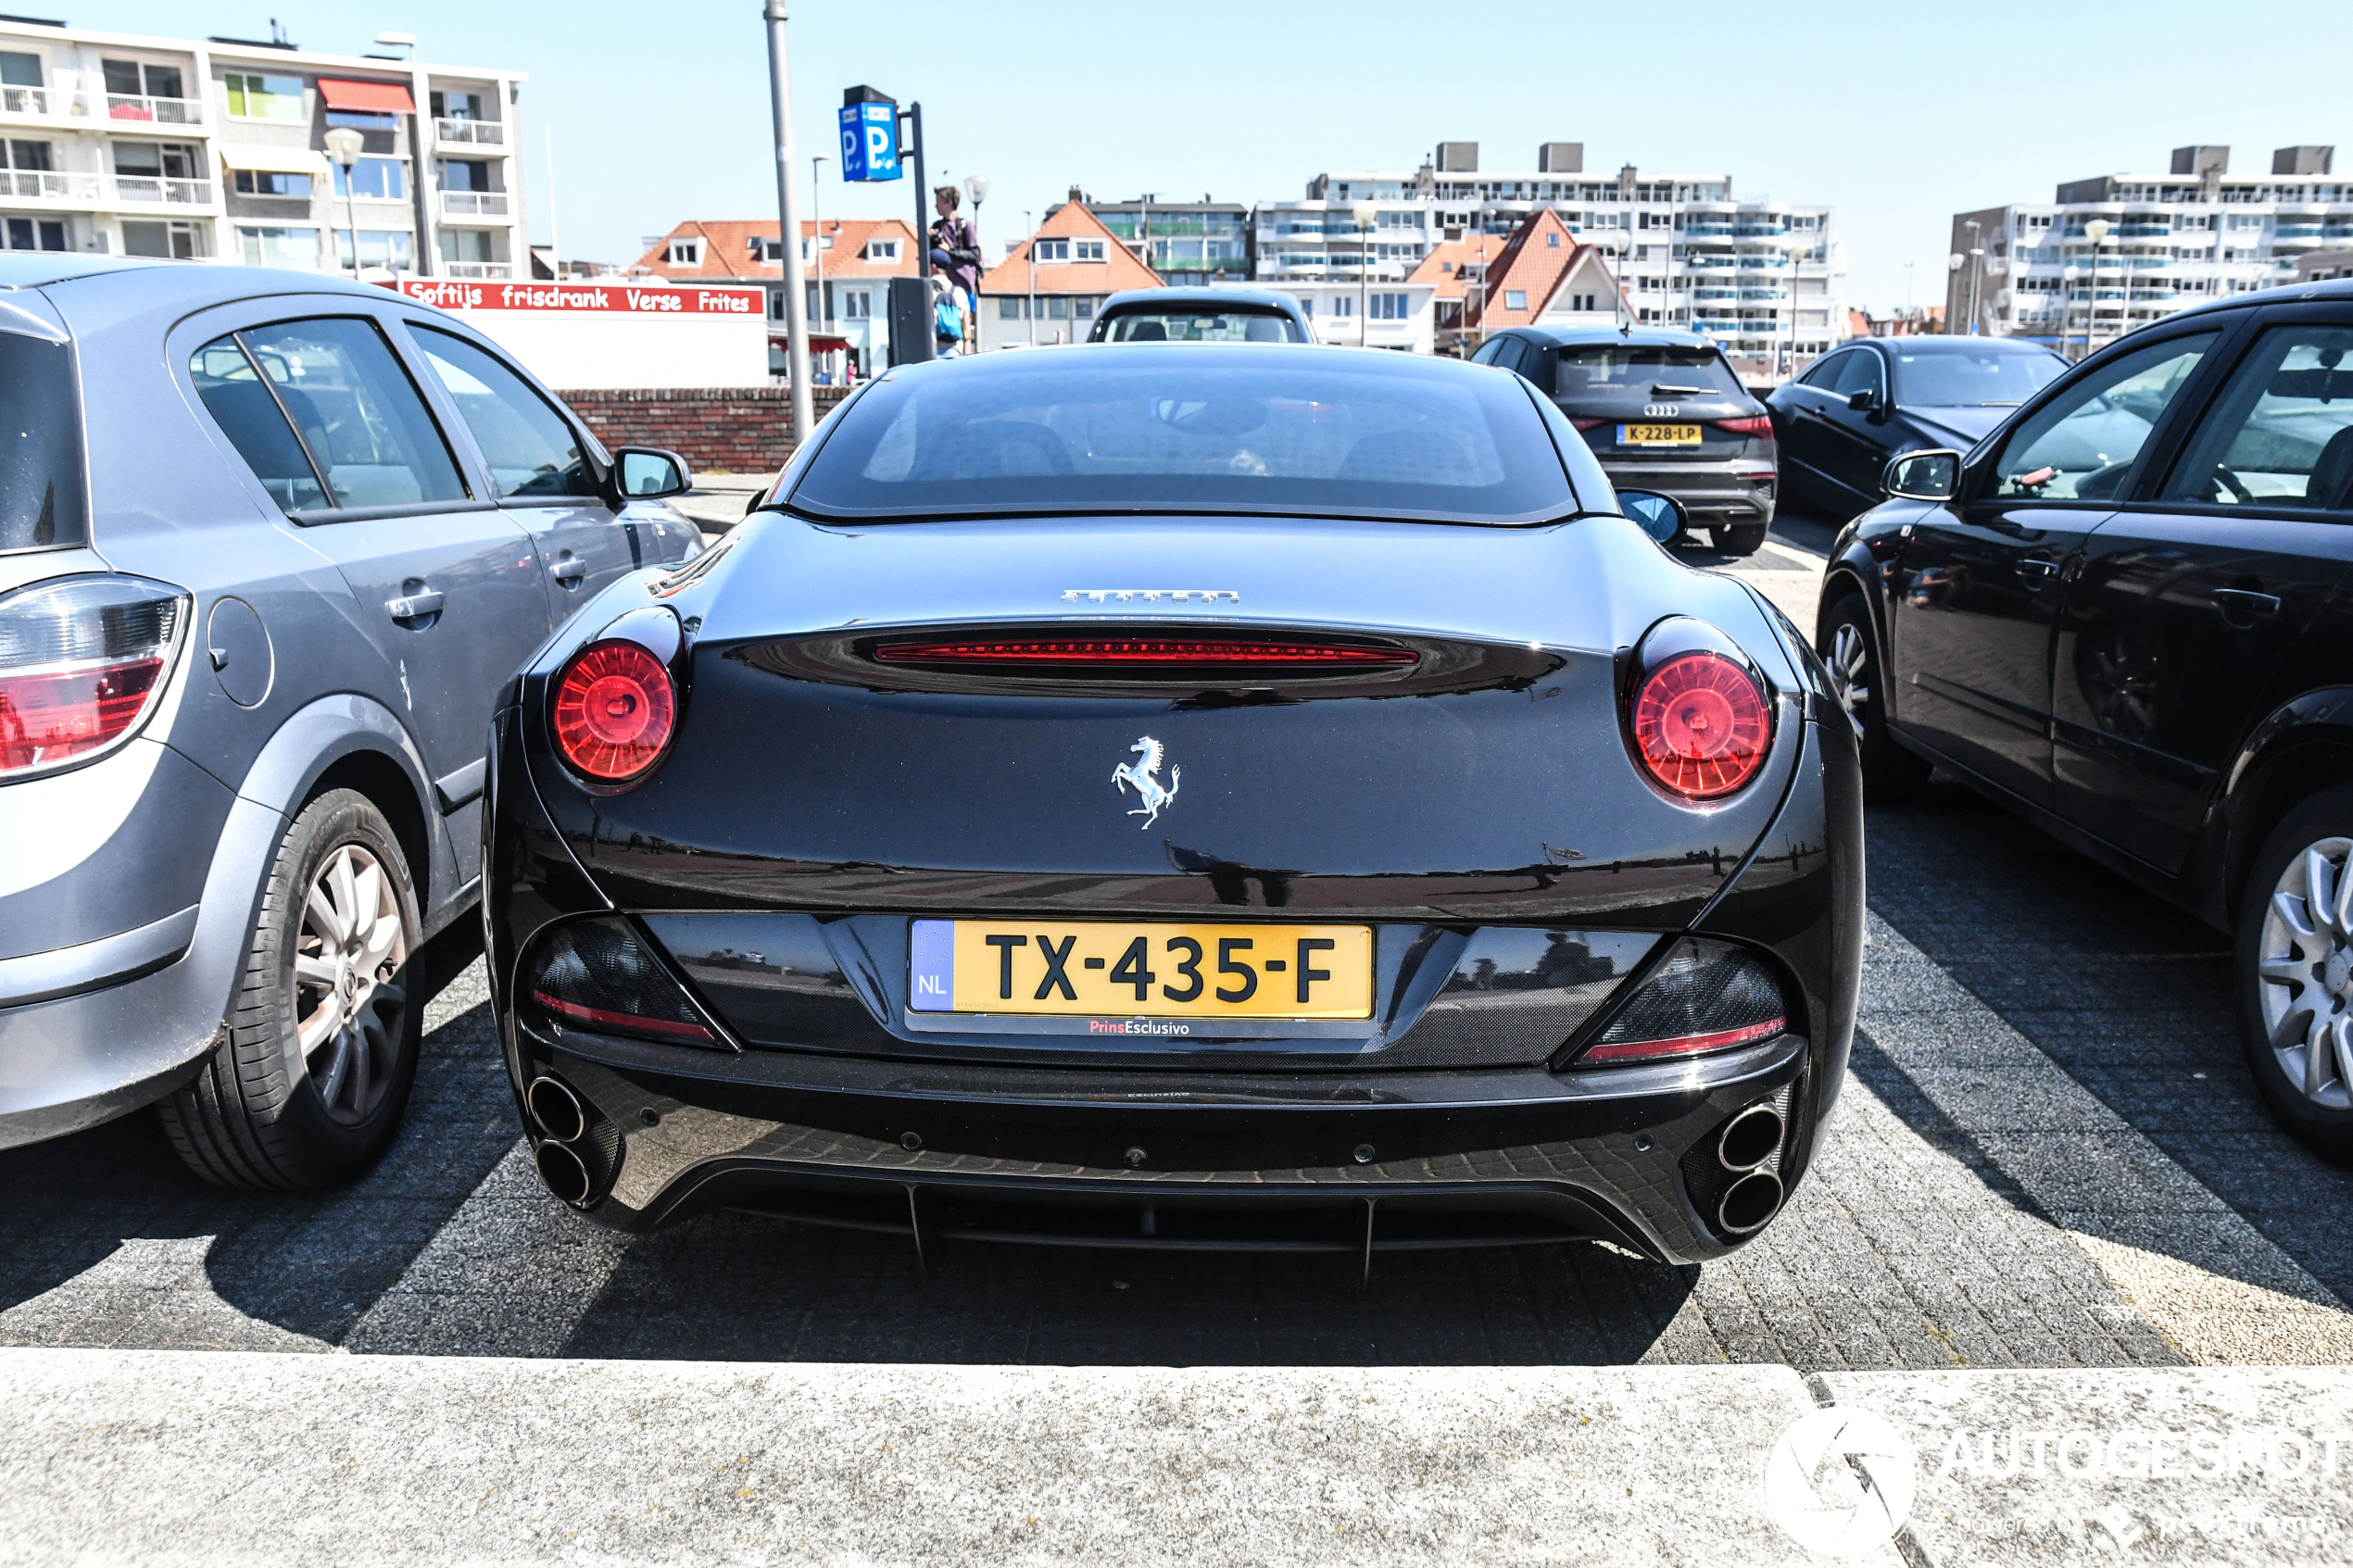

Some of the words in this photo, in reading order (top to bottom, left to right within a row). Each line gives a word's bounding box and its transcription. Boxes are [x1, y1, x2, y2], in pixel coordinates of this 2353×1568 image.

[842, 130, 858, 172] P
[866, 126, 889, 169] P
[410, 282, 482, 309] Softijs
[501, 285, 609, 307] frisdrank
[626, 289, 682, 311] Verse
[698, 292, 749, 312] Frites
[1630, 427, 1695, 440] K-228-LP
[919, 975, 947, 994] NL
[986, 935, 1335, 1003] TX-435-F
